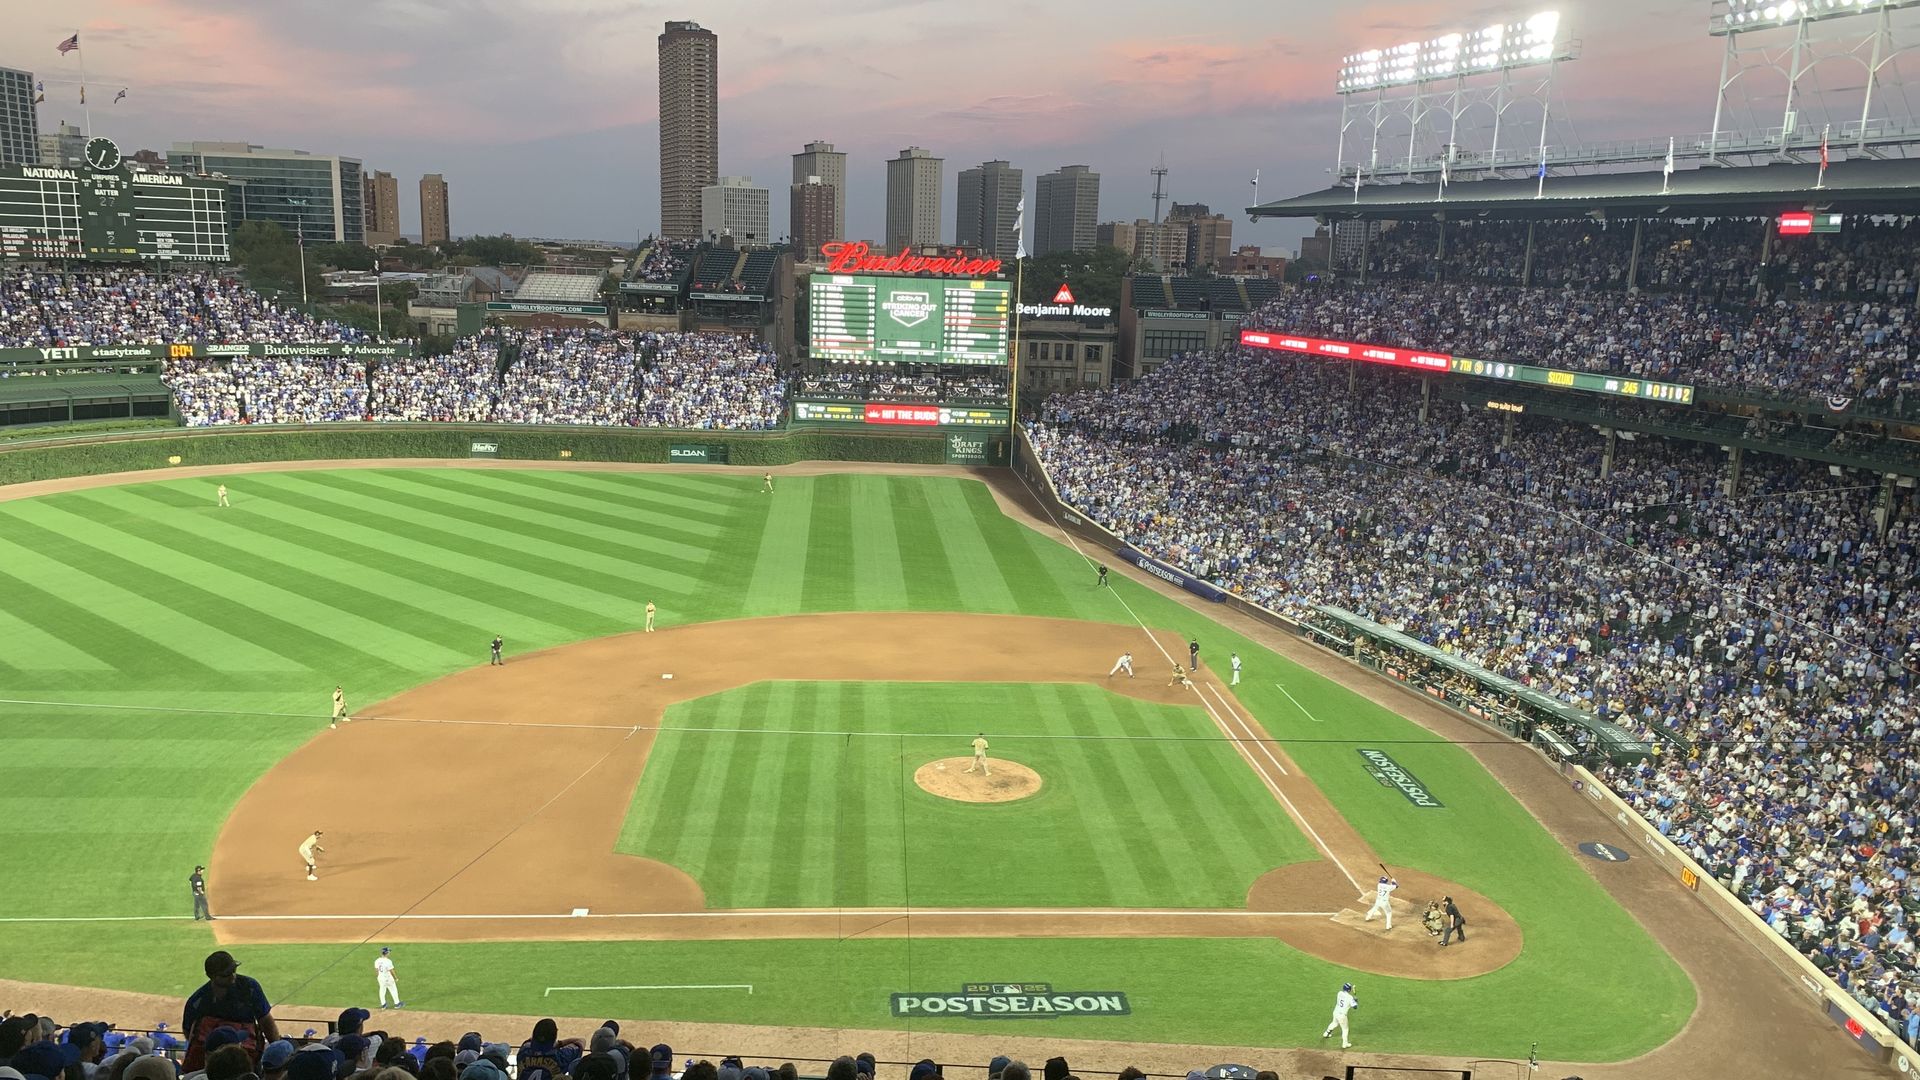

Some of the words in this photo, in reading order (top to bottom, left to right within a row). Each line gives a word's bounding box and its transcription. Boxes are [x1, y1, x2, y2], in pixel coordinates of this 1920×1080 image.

[23, 168, 79, 180] NATIONAL
[91, 174, 120, 182] UMPIRES
[132, 174, 183, 185] AMERICAN
[94, 189, 119, 197] BATTER
[821, 241, 1002, 274] Budweiser
[882, 302, 920, 310] STRIKING
[921, 303, 937, 311] OUT
[1016, 303, 1070, 317] Benjamin
[1072, 304, 1111, 316] Moore
[894, 309, 925, 317] CANCER
[39, 347, 79, 360] YETI
[100, 348, 151, 358] tastytrade
[171, 345, 193, 357] 0:04
[206, 344, 250, 352] GRAINGER
[354, 345, 396, 354] Advocate
[1460, 360, 1472, 372] 7TH
[1508, 366, 1514, 378] 3
[1547, 371, 1575, 386] SUZUKI
[1621, 381, 1638, 394] .245
[1652, 384, 1660, 397] 0
[1682, 388, 1690, 401] 2
[882, 409, 896, 419] HIT
[897, 409, 913, 420] THE
[914, 410, 937, 421] BUDS
[473, 443, 497, 452] Hefty
[952, 441, 984, 449] DRAFT
[671, 449, 706, 457] SLOAN
[1144, 561, 1175, 583] POSTSEASON
[1362, 750, 1439, 806] POSTSEASON
[898, 996, 1122, 1013] POSTSEASON
